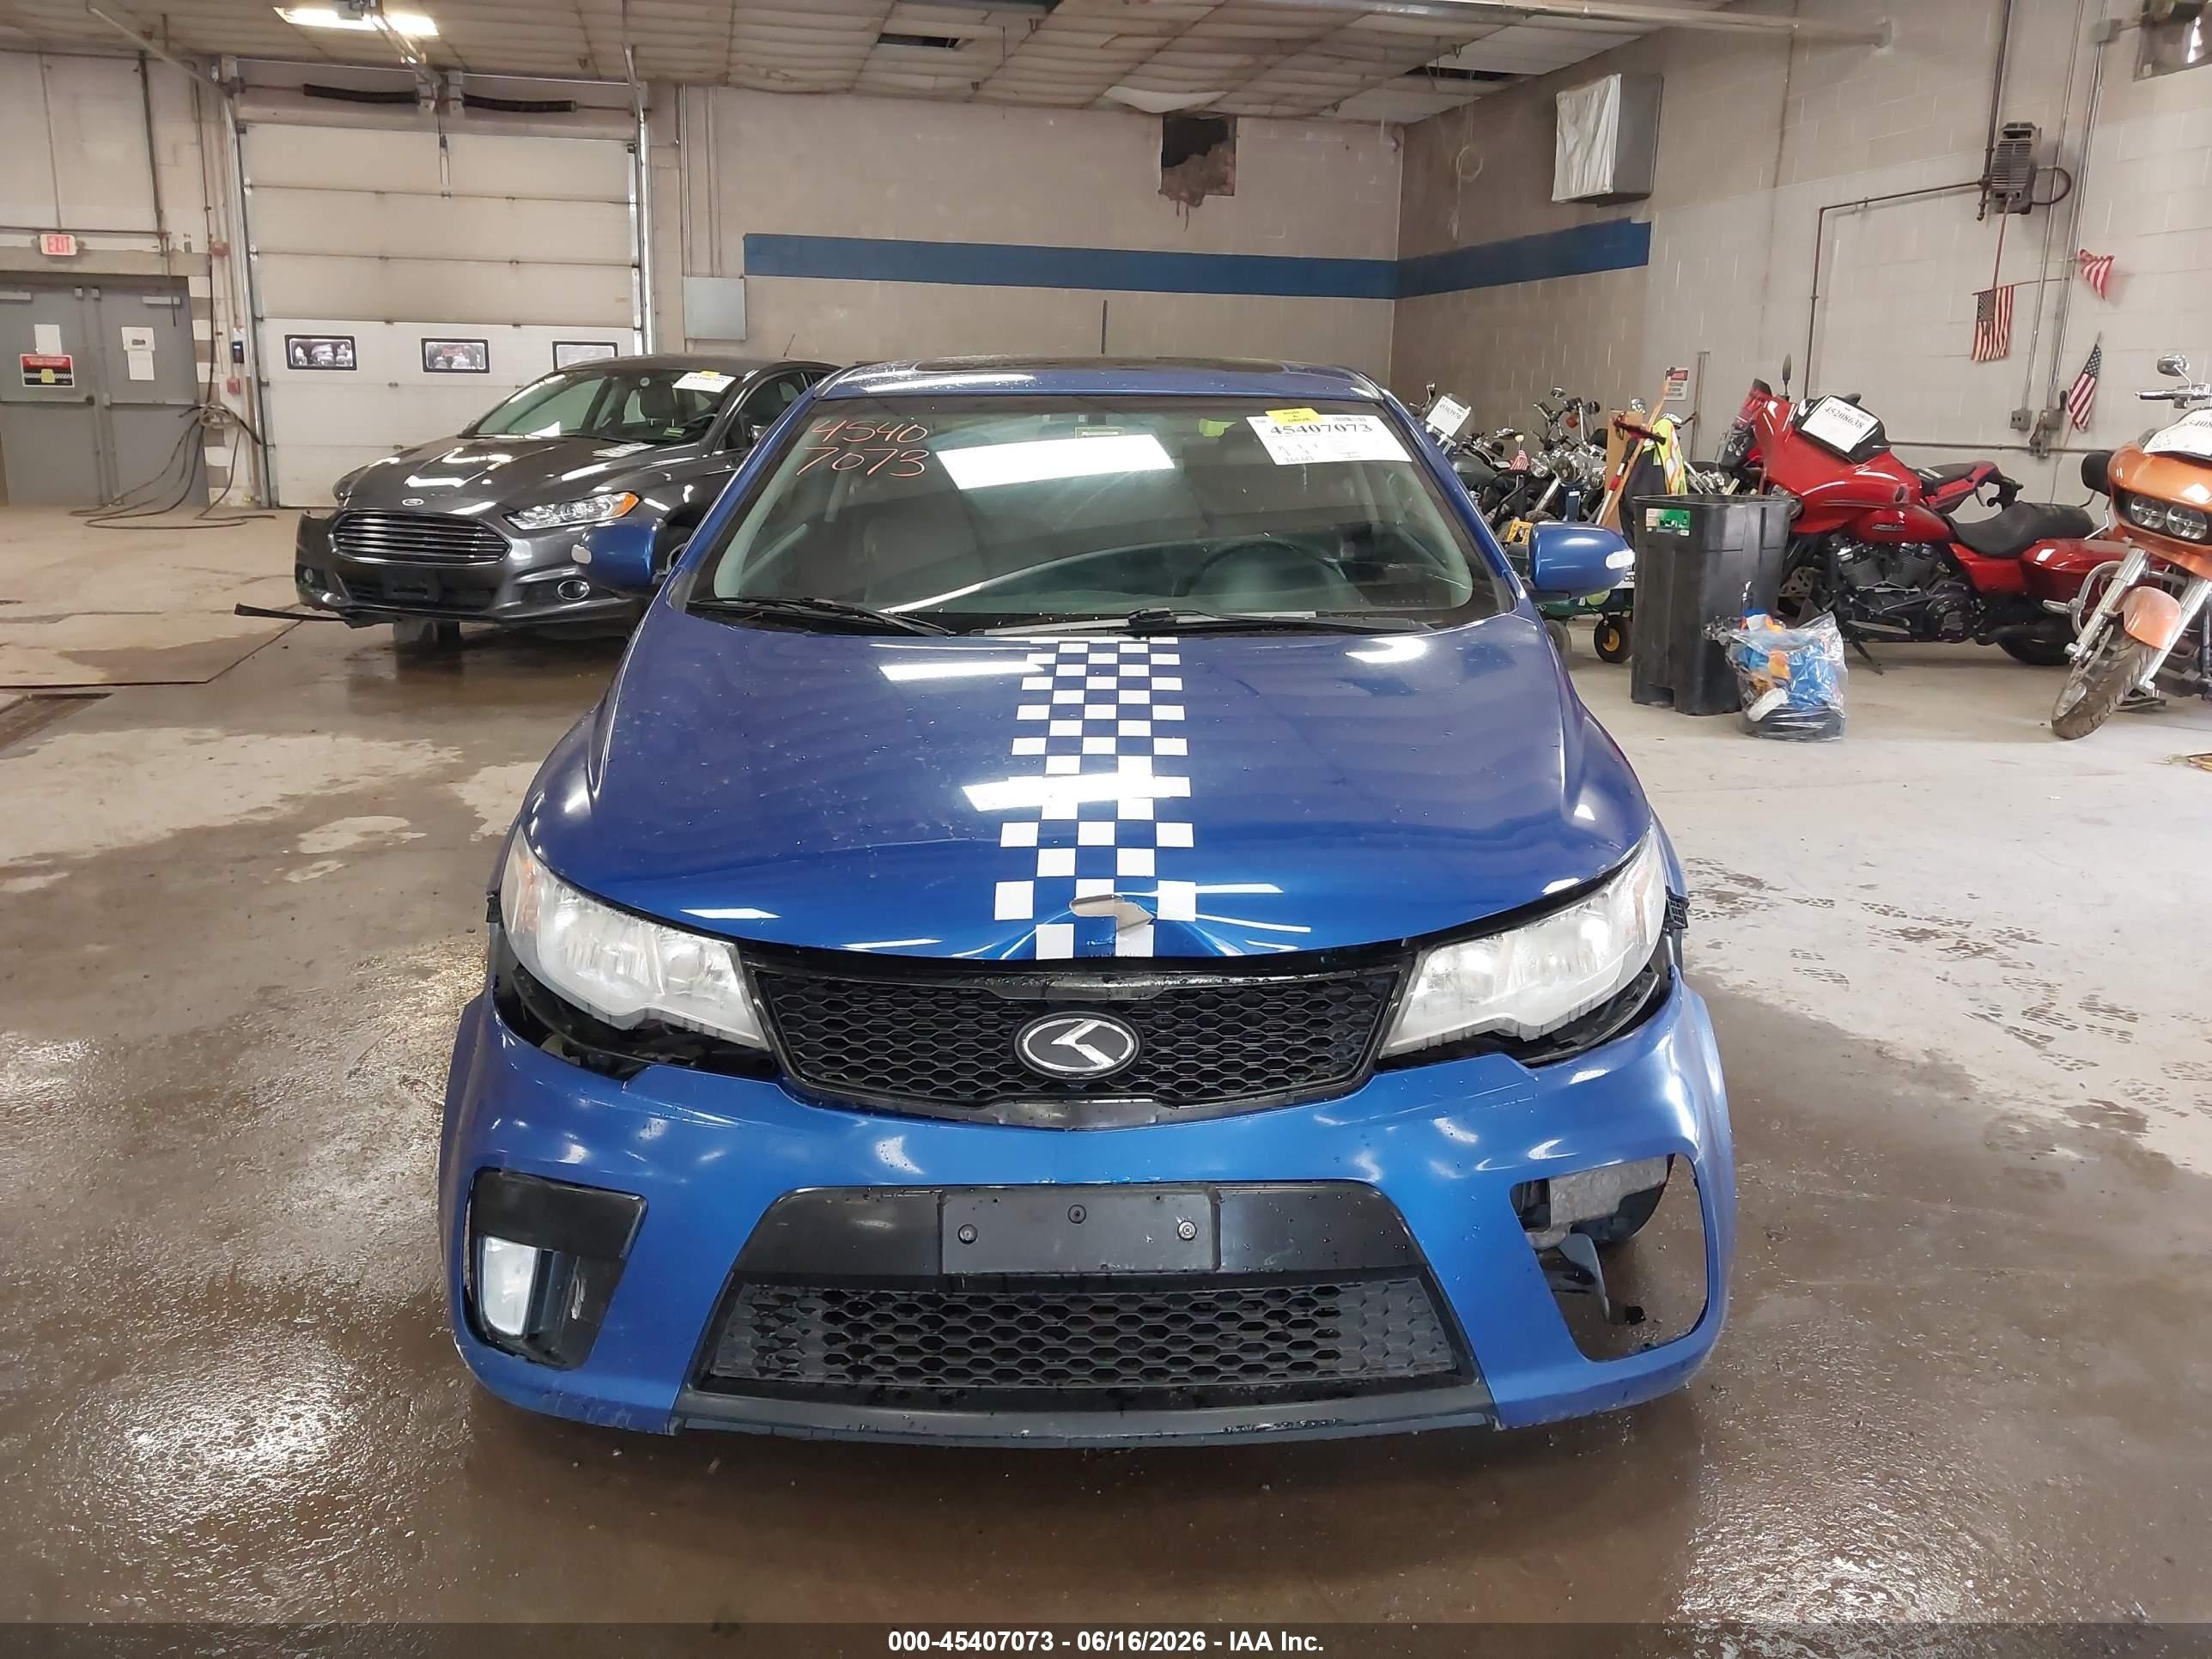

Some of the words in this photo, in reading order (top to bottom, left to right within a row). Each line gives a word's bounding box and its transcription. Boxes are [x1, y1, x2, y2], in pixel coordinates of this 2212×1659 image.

[811, 419, 928, 443] 4540
[1270, 423, 1373, 434] 45407073
[796, 446, 930, 477] 7073
